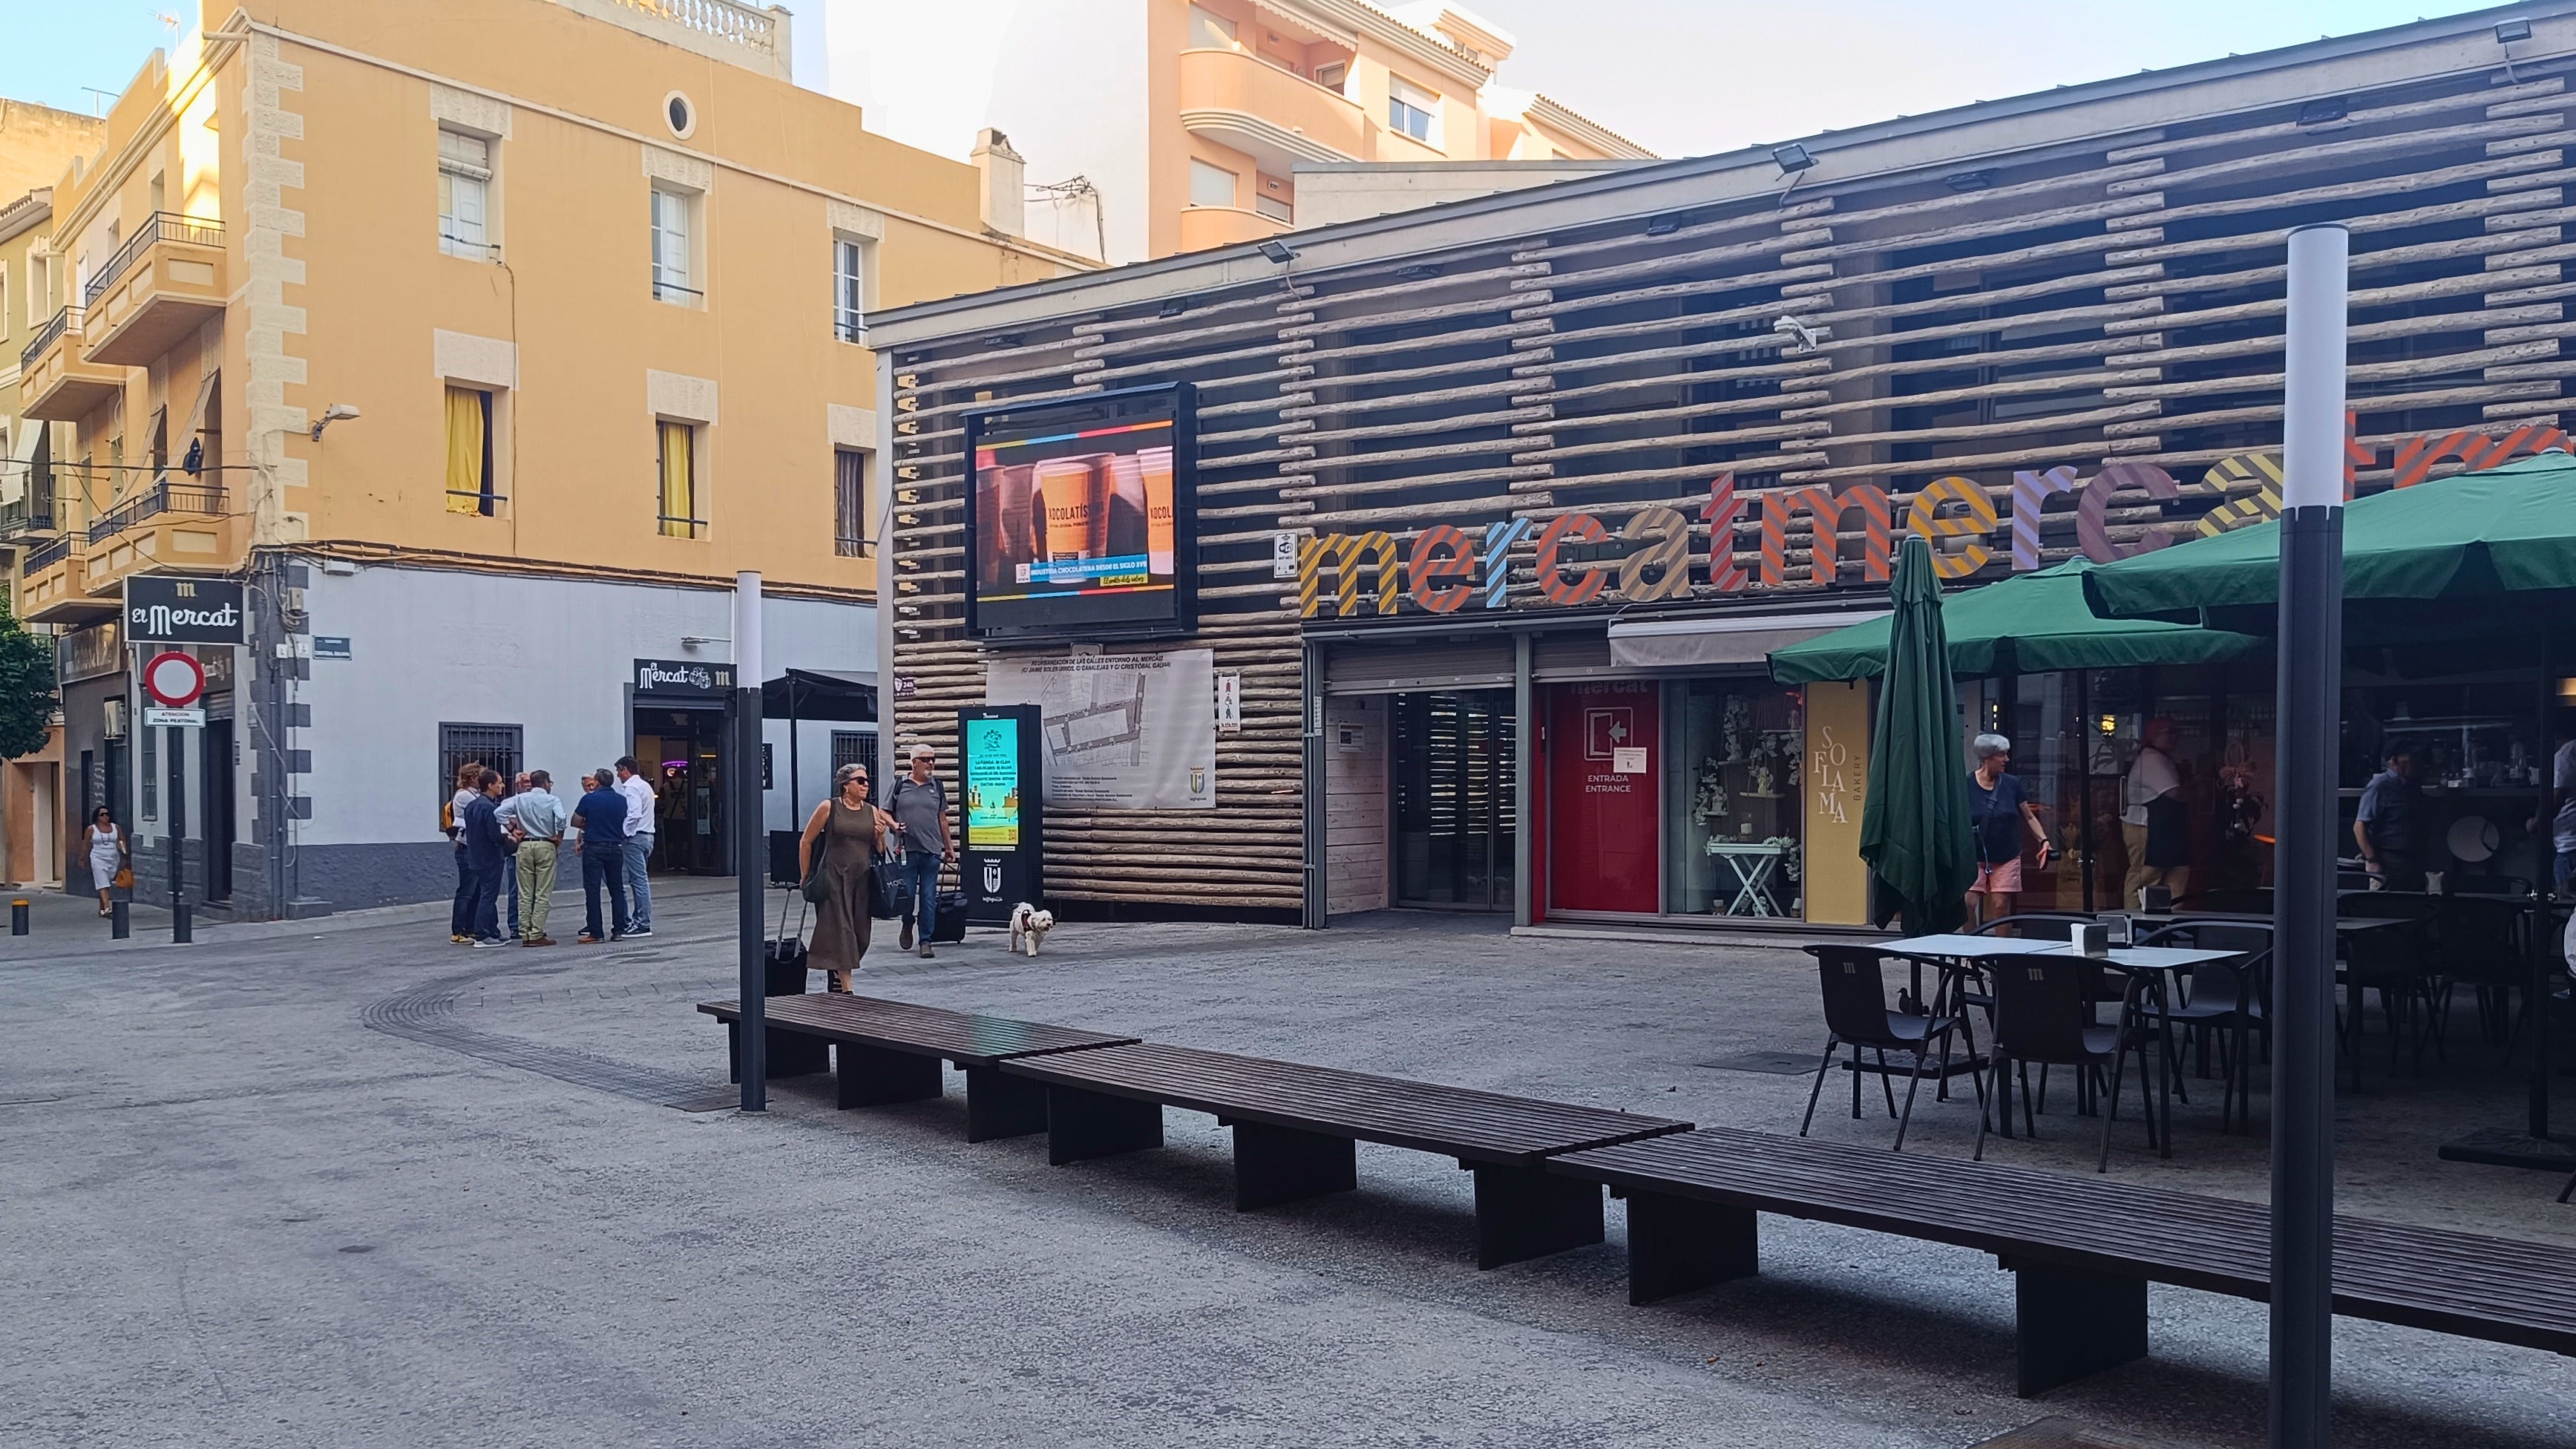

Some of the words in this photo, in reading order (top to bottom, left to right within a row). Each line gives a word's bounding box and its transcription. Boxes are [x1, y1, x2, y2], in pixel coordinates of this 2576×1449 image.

[1058, 565, 1095, 574] CHOCOLATERA
[132, 608, 148, 623] El
[148, 603, 239, 635] Mercat
[639, 666, 689, 689] Mercat
[1853, 756, 1861, 801] BAKERY
